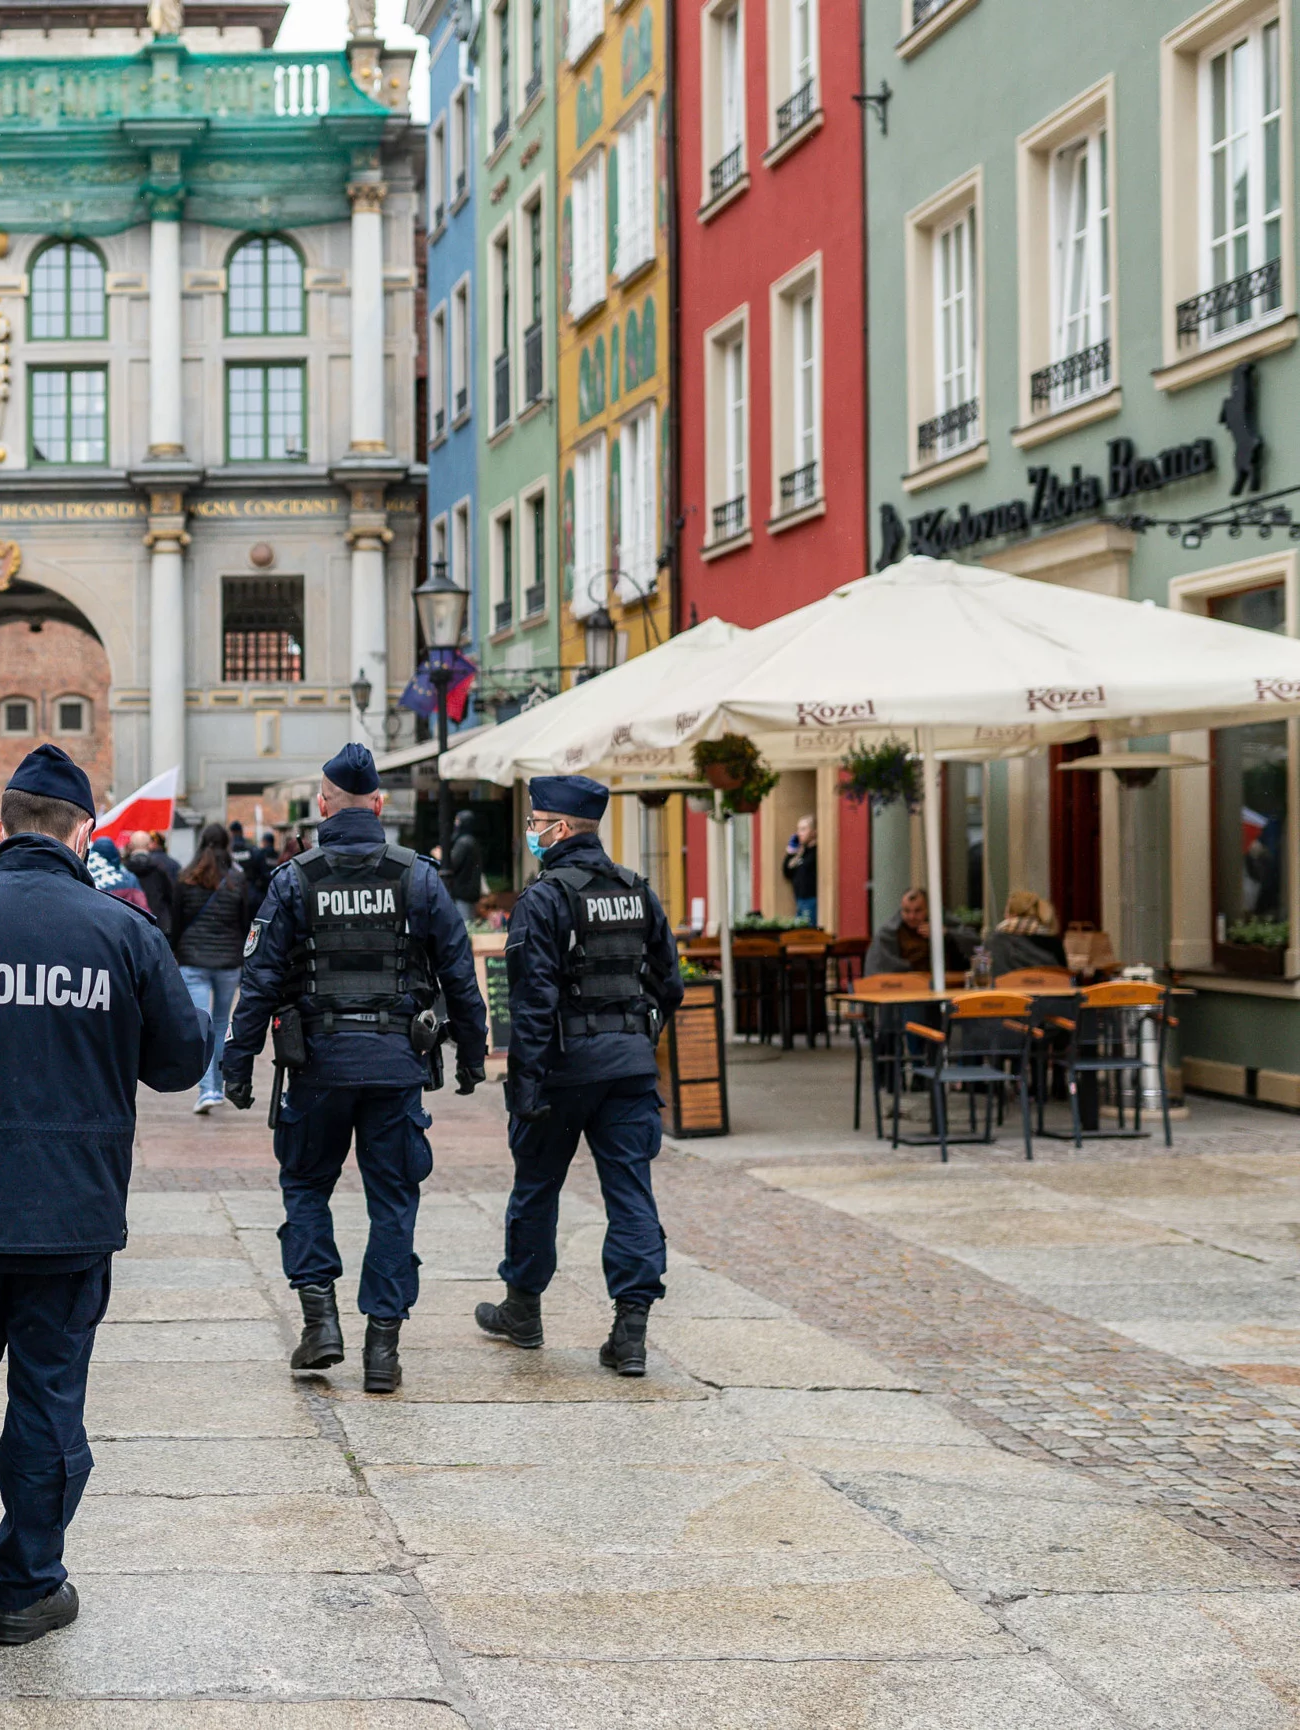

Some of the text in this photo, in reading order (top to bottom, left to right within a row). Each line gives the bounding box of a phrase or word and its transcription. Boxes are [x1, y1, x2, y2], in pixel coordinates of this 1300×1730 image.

[1106, 436, 1216, 500] Brama
[1027, 684, 1106, 711] Kozel
[796, 698, 878, 726] Kozel
[317, 888, 396, 916] POLICJA
[586, 895, 644, 922] POLICJA
